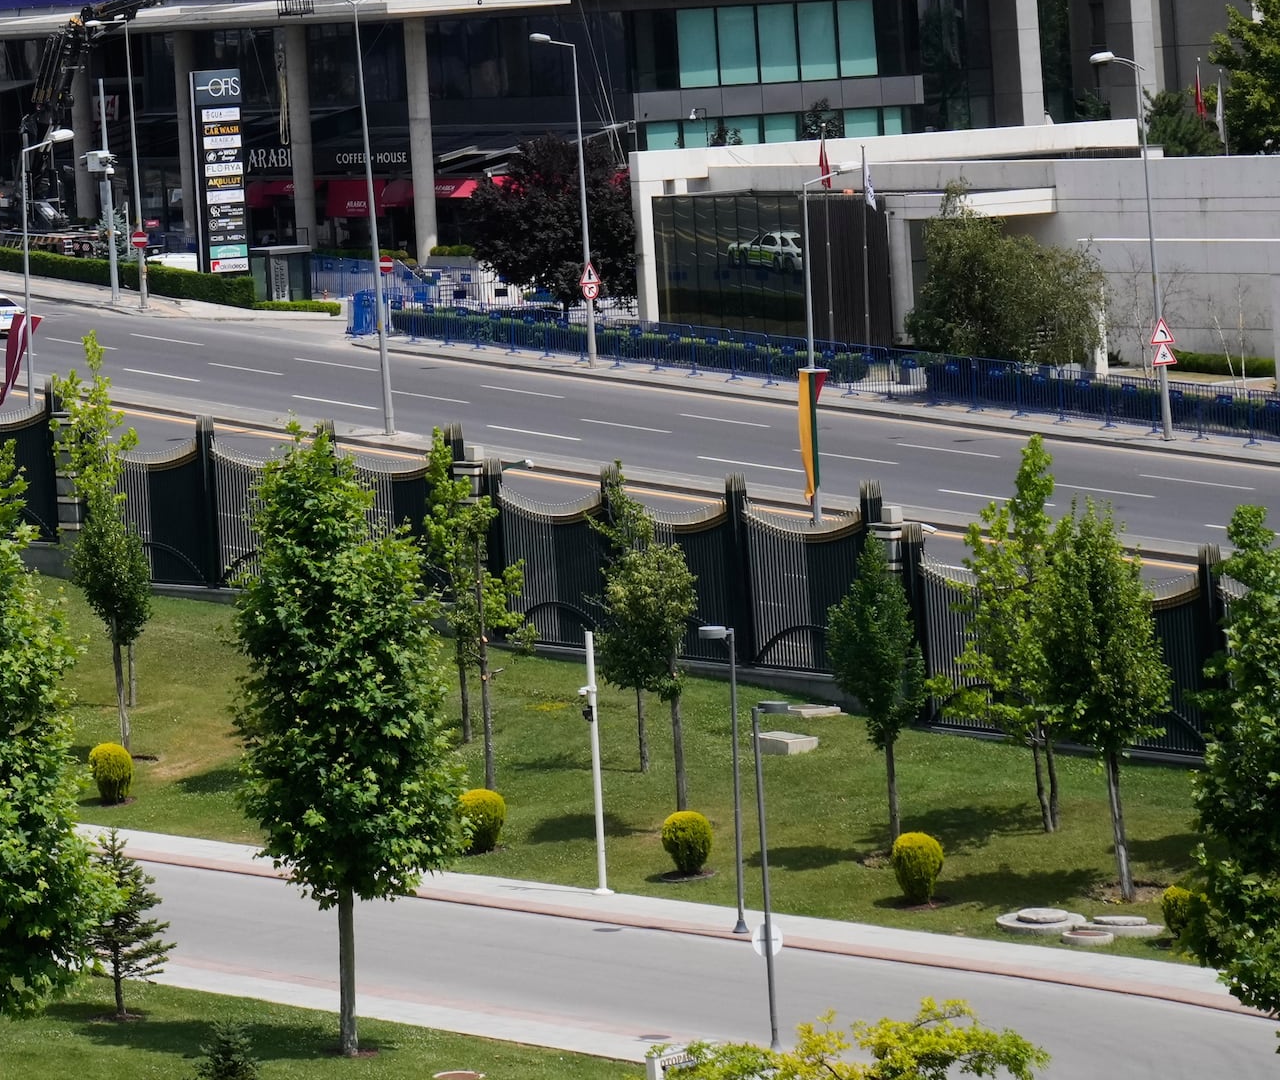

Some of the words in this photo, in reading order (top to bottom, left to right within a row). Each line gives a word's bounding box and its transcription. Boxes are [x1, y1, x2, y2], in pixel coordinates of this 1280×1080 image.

[204, 126, 219, 135] CAR
[220, 125, 239, 134] WASH
[336, 153, 367, 164] COFFEE
[377, 152, 407, 163] HOUSE
[207, 164, 241, 173] FLORYA
[208, 177, 241, 187] AKBULUT
